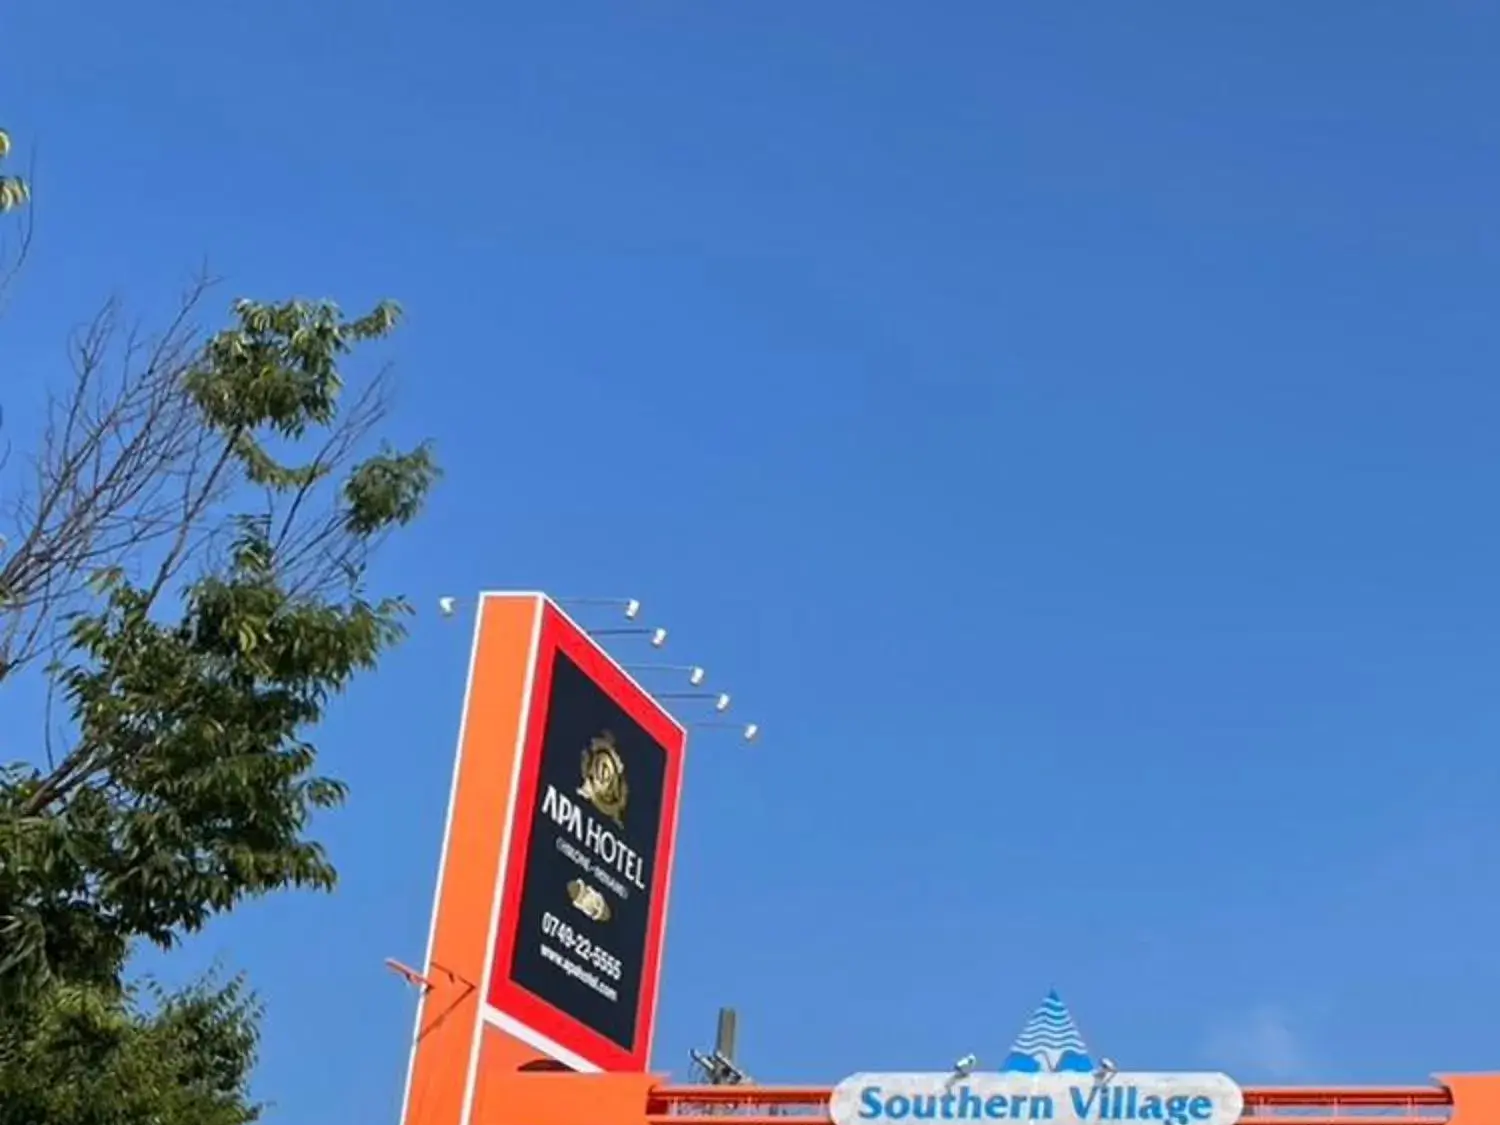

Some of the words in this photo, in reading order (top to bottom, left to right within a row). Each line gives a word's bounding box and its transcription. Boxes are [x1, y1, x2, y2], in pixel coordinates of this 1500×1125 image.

[541, 783, 583, 842] APA
[585, 816, 646, 891] HOTEL
[858, 1082, 1053, 1121] Southern
